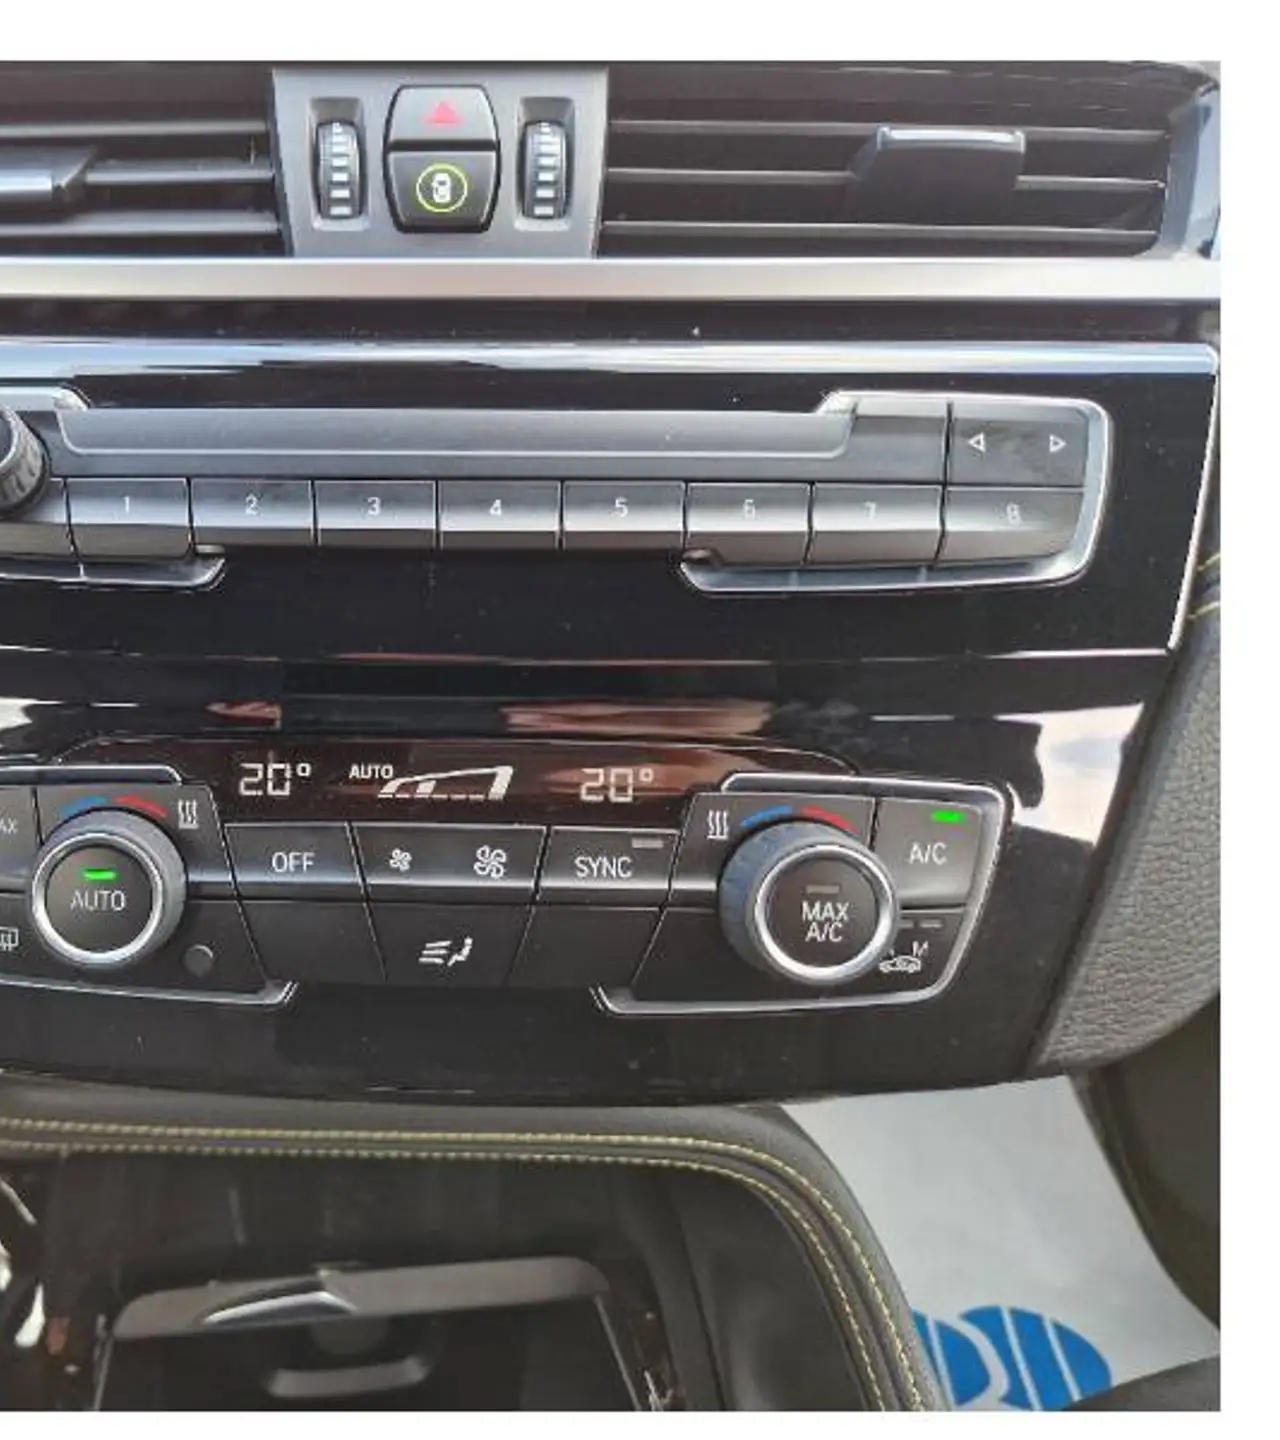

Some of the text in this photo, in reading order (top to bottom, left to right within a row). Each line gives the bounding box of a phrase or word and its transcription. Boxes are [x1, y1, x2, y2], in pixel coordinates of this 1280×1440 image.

[123, 496, 131, 513] 1
[244, 494, 258, 516] 2
[367, 496, 381, 517] 3
[489, 499, 502, 516] 4
[613, 498, 629, 518] 5
[864, 501, 877, 519] 7
[348, 764, 394, 780] AUTO
[271, 851, 315, 874] OFF
[908, 842, 948, 866] A/C
[574, 856, 633, 879] SYNC
[70, 889, 127, 911] AUTO
[801, 901, 850, 922] MAX
[804, 923, 843, 943] A/C
